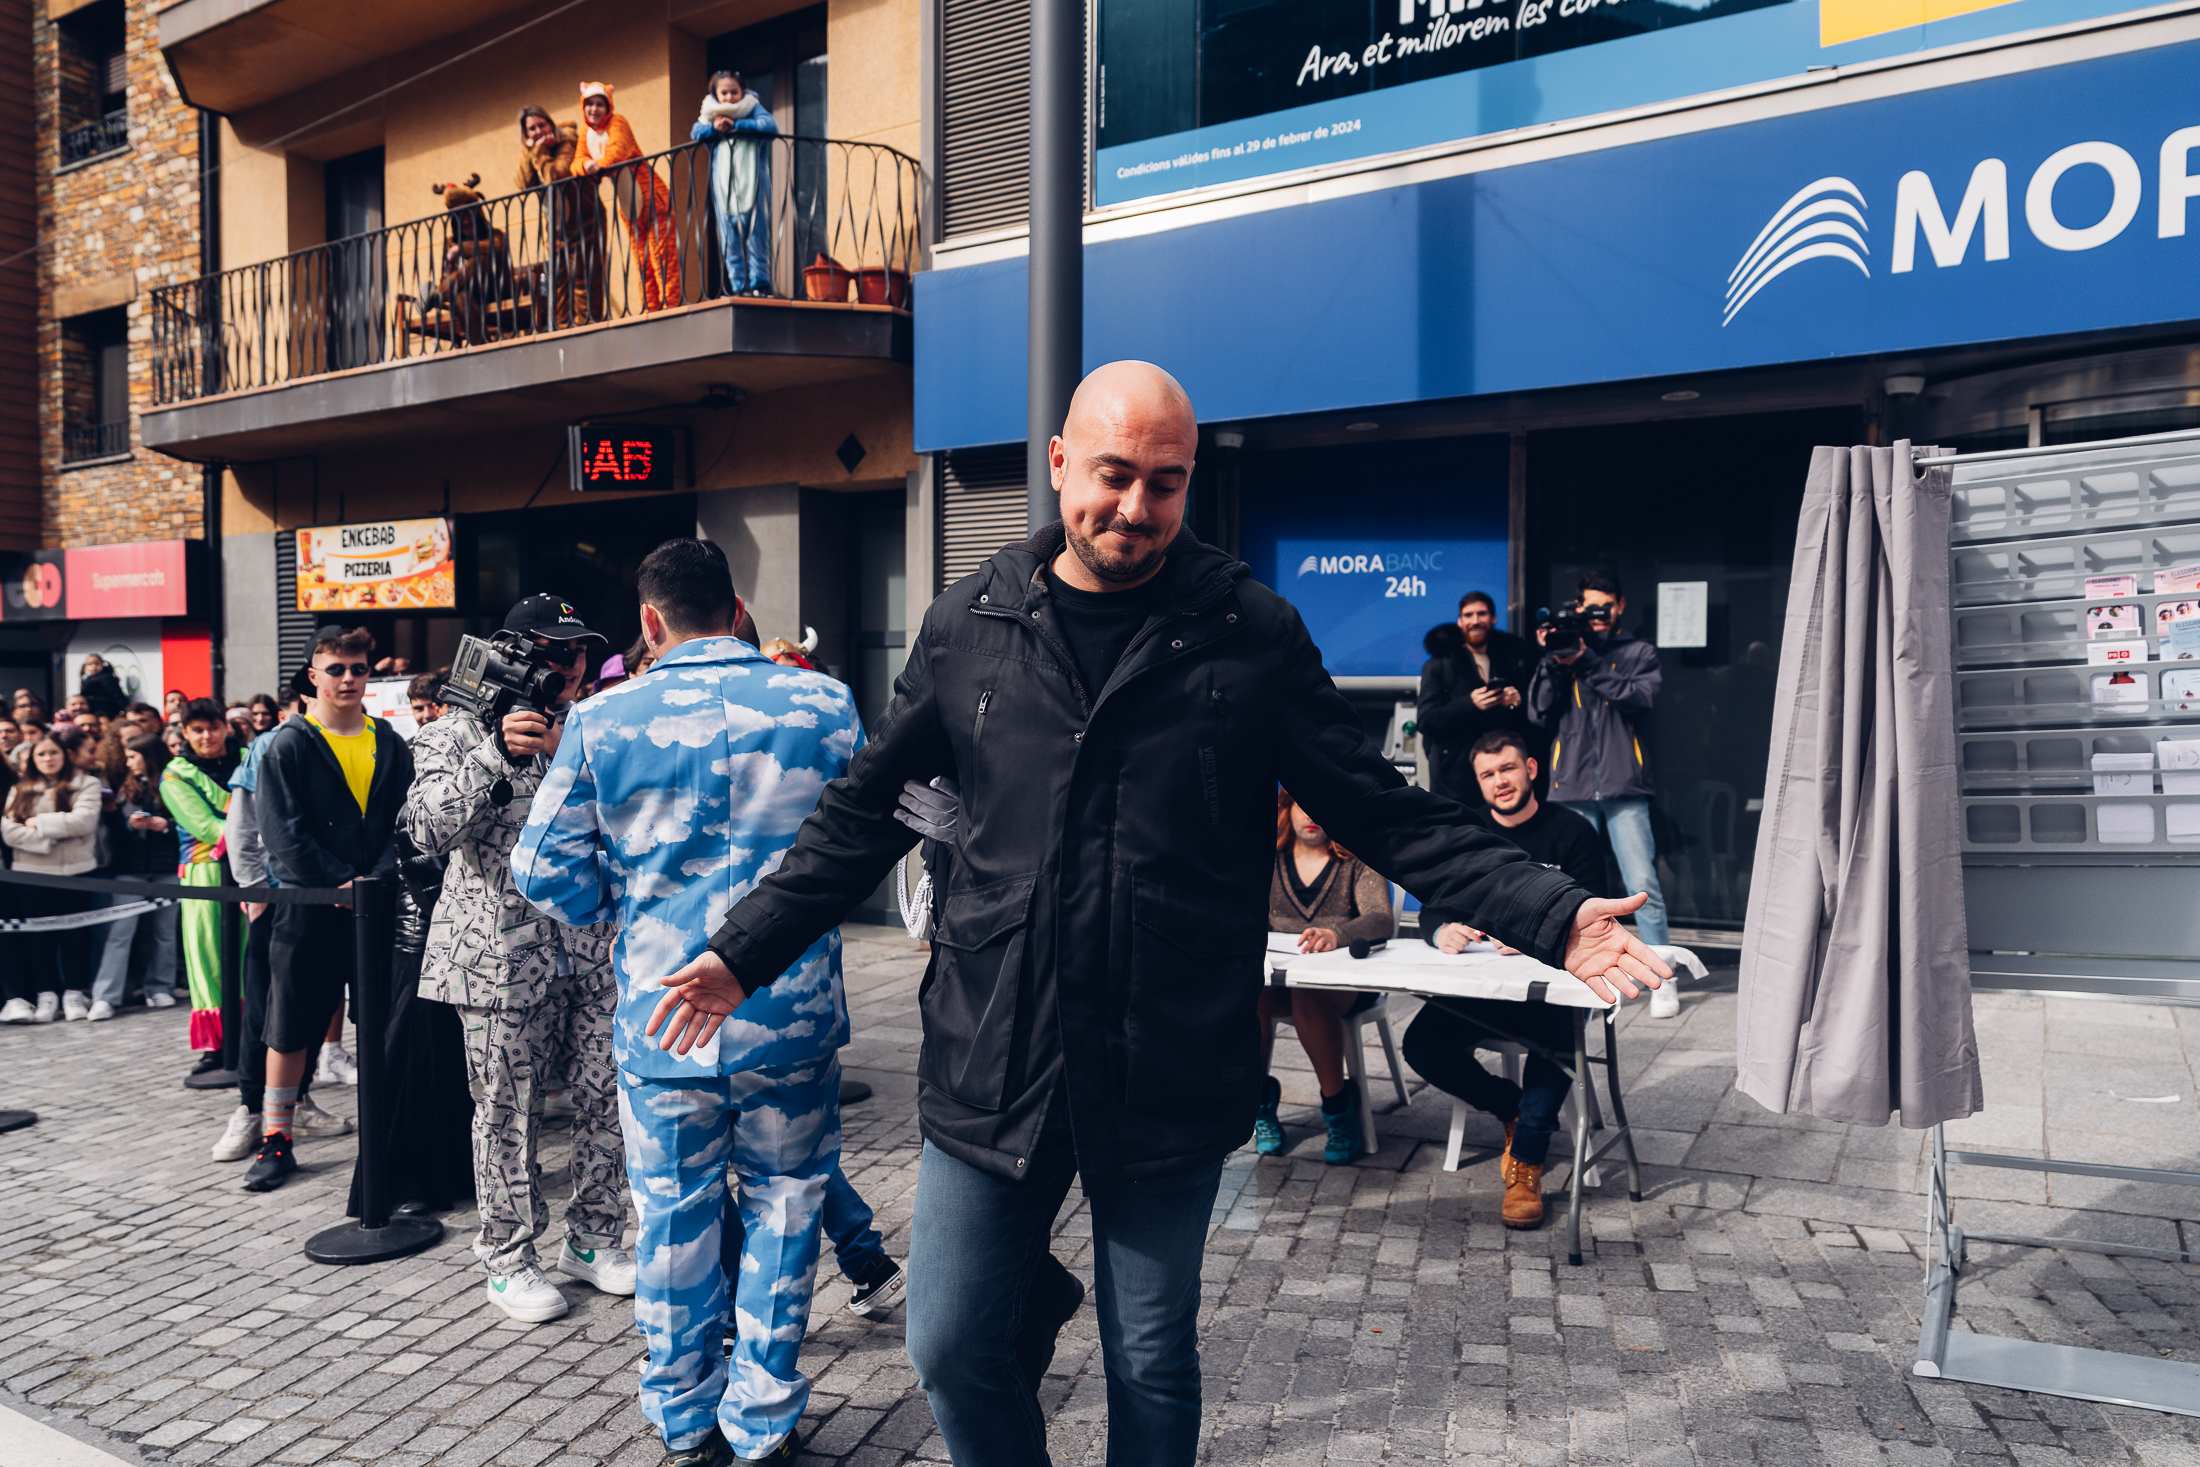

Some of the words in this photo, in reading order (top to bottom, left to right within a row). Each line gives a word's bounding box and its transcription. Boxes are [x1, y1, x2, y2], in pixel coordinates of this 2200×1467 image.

[1296, 45, 1359, 87] Ara,
[1362, 32, 1394, 67] et
[1396, 12, 1510, 58] millorem
[1515, 0, 1553, 30] les
[1116, 158, 1171, 179] Condicions
[1172, 151, 1210, 168] vàlides
[1211, 146, 1232, 160] fins
[1233, 142, 1245, 156] al
[1246, 140, 1261, 154] 29
[1262, 136, 1277, 150] de
[1278, 129, 1312, 147] febrer
[1313, 125, 1329, 140] de
[1330, 118, 1362, 137] 2024
[342, 525, 396, 548] ENKEBAB
[344, 560, 392, 578] PIZZERIA
[1384, 575, 1426, 598] 24h
[1204, 746, 1216, 774] VRC3
[1208, 776, 1218, 798] YTH
[1210, 801, 1220, 825] 1990
